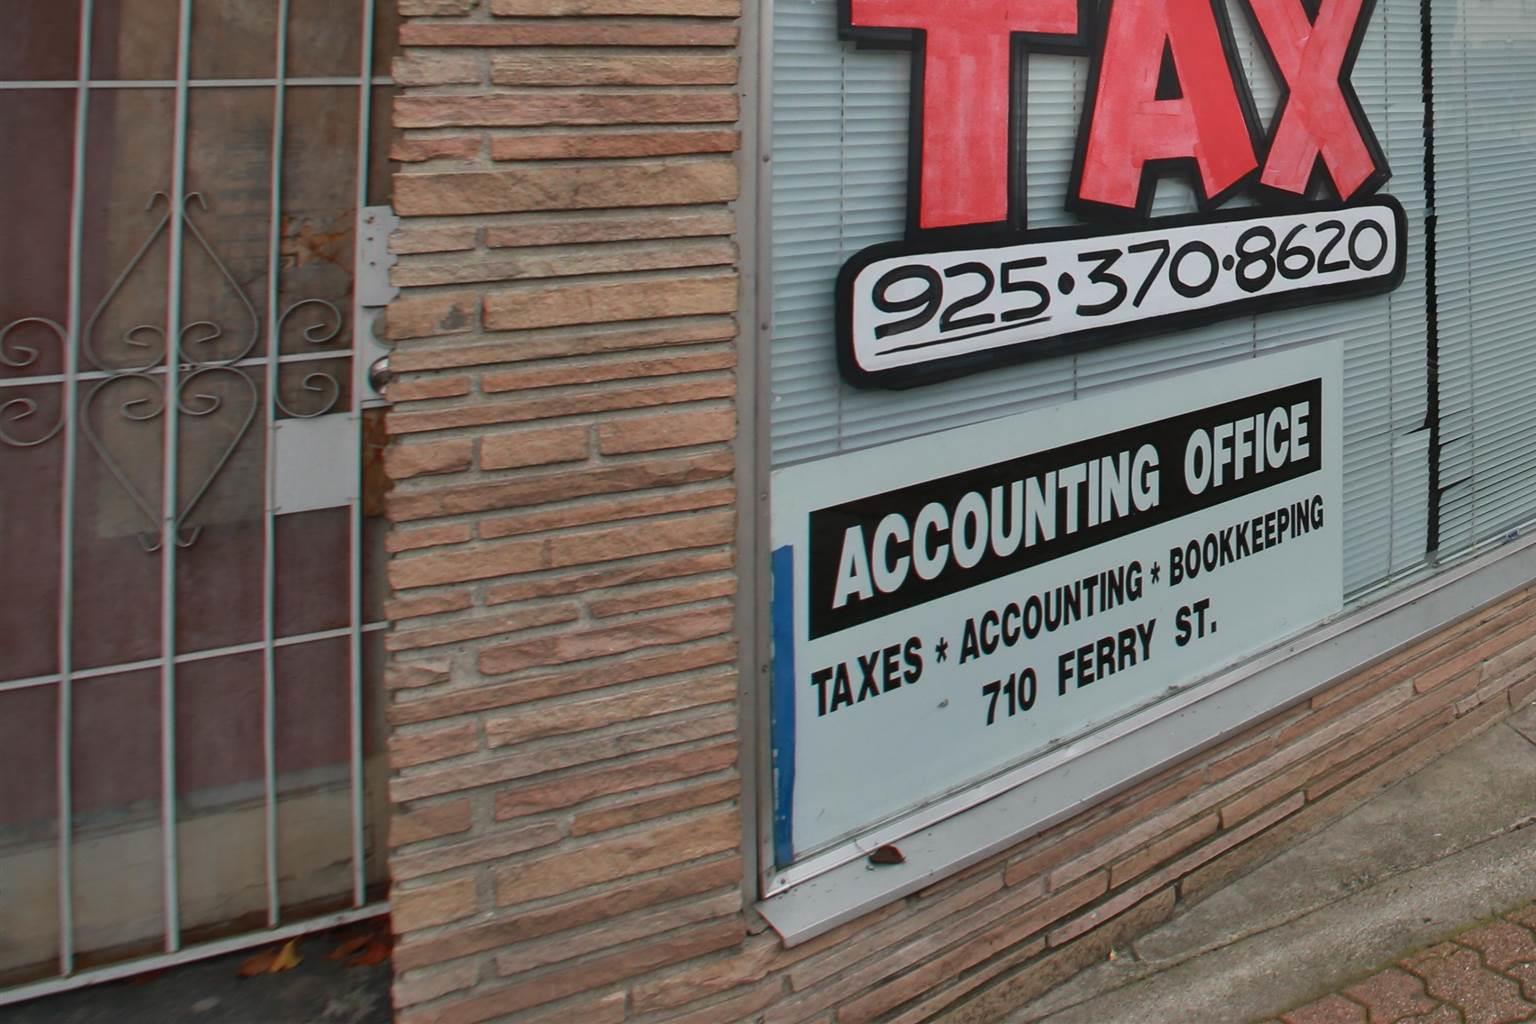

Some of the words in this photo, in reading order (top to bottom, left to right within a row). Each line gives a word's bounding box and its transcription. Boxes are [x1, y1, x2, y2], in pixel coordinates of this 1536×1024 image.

[811, 637, 923, 717] TAXES
[959, 561, 1143, 665] ACCOUNTING
[1169, 494, 1324, 587] BOOKKEEPING
[831, 443, 1160, 611] ACCOUNTING
[1184, 401, 1311, 496] OFFICE
[982, 667, 1036, 727] 710
[1058, 619, 1157, 696] FERRY
[1175, 598, 1218, 647] ST.
